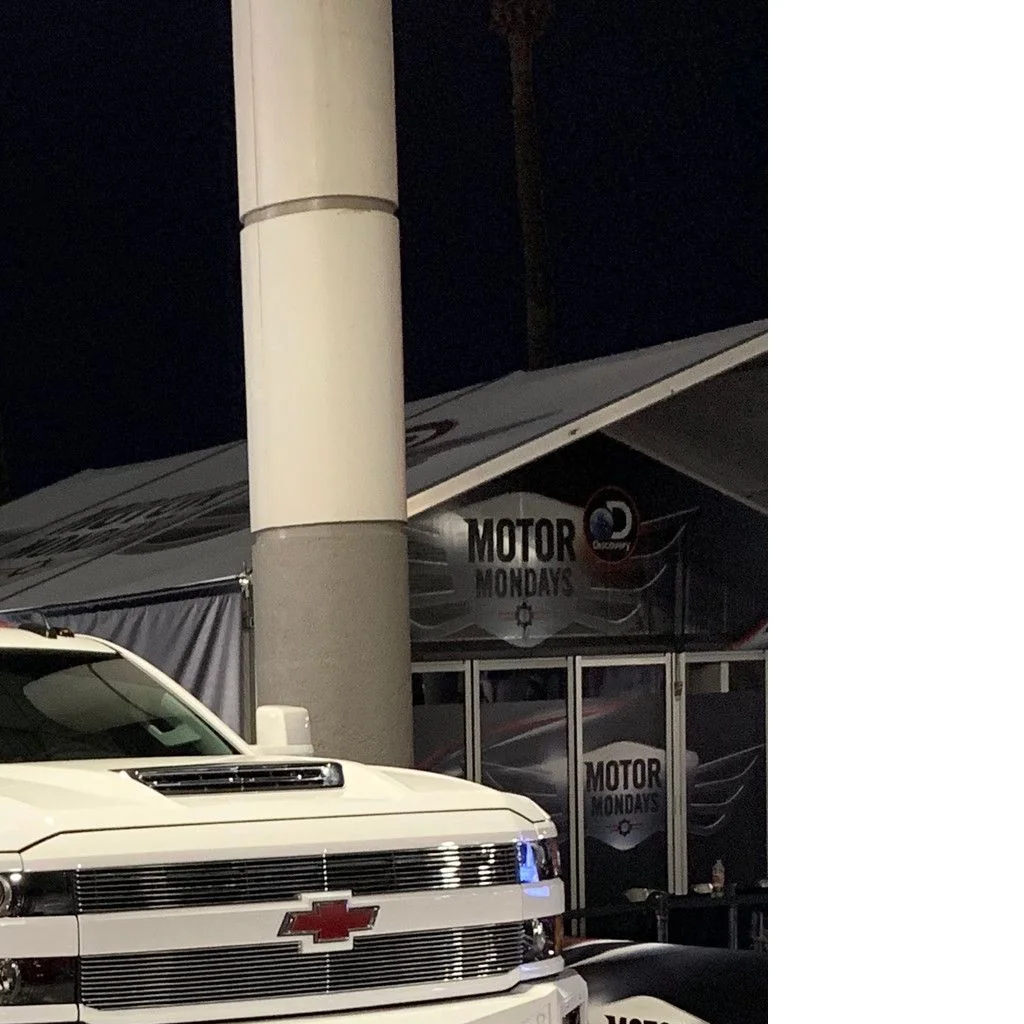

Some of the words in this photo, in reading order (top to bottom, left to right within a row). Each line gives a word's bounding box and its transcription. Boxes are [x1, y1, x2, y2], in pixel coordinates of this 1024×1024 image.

[464, 517, 576, 563] MOTOR
[477, 568, 575, 599] MONDAYS
[584, 757, 662, 793] MOTOR
[590, 793, 660, 817] MONDAYS
